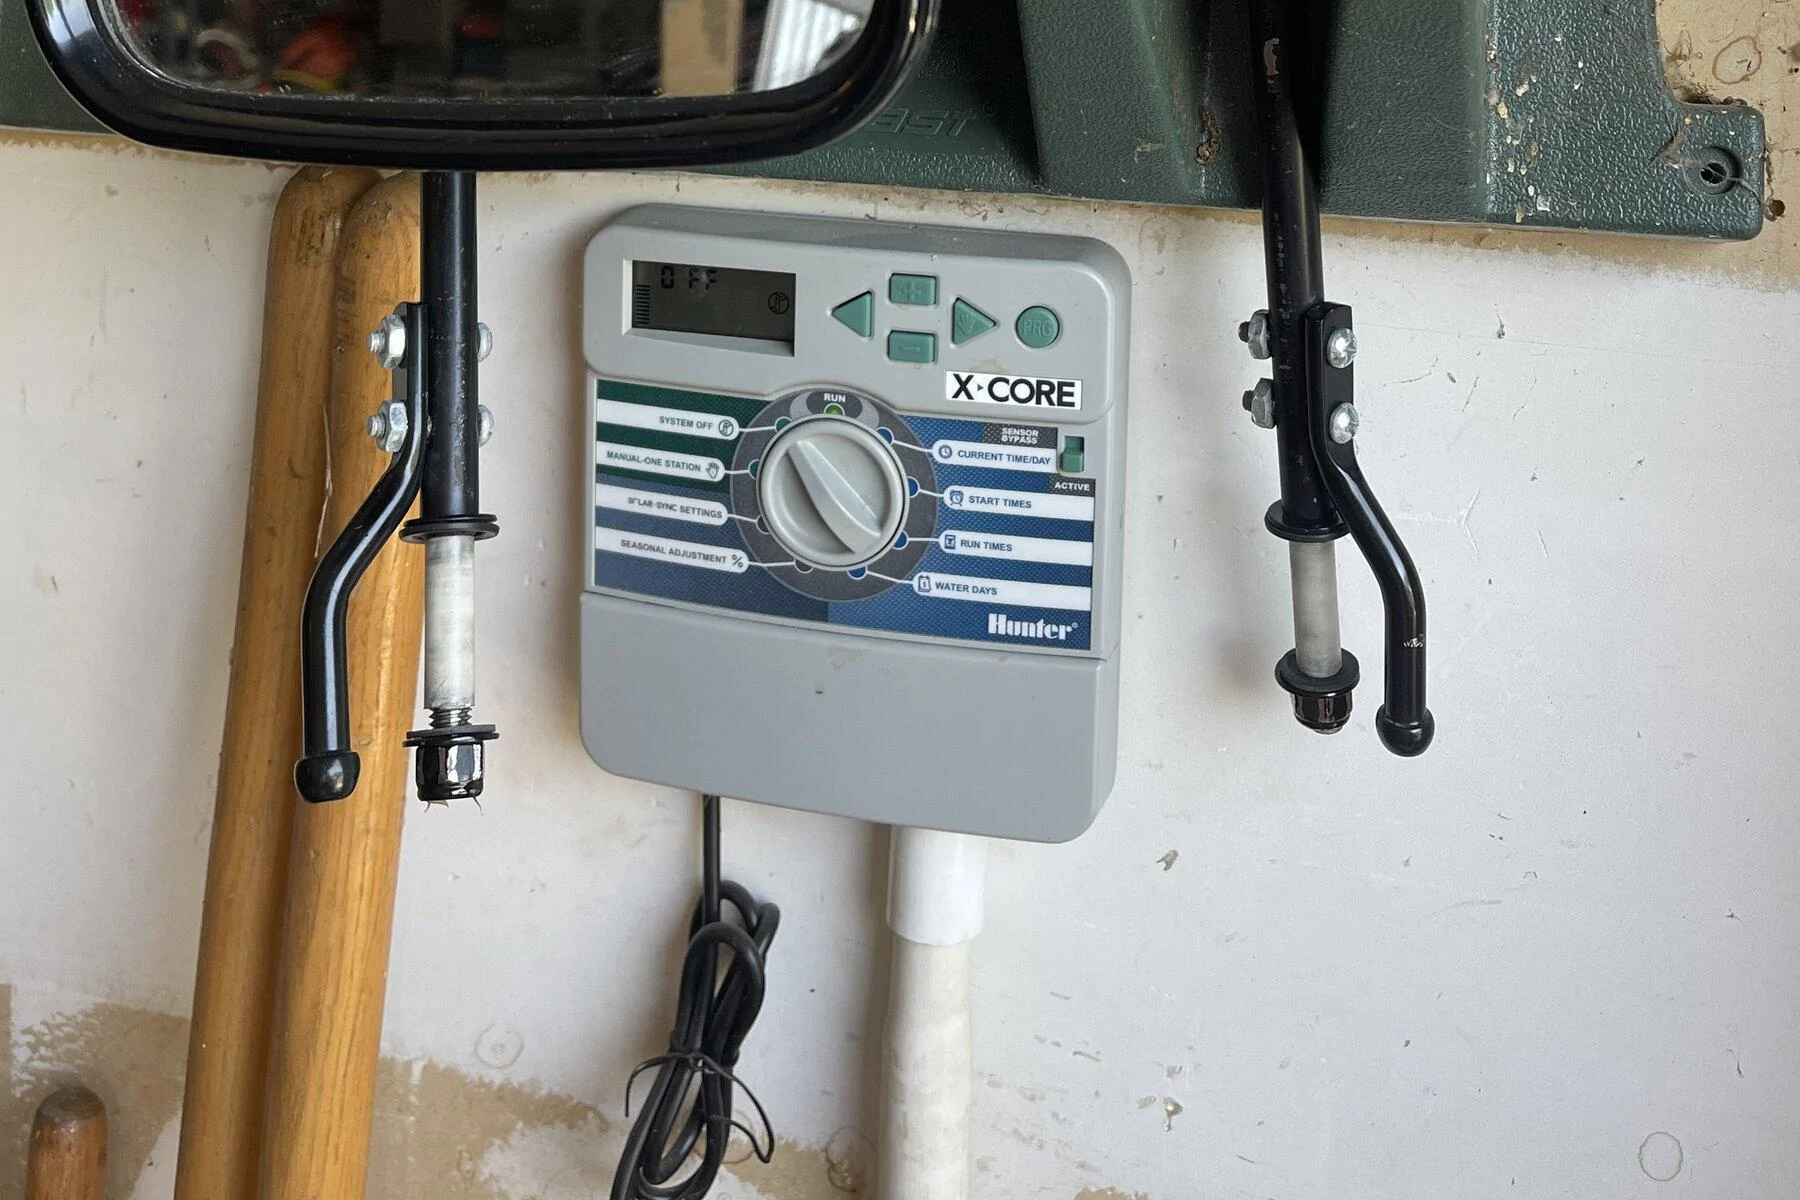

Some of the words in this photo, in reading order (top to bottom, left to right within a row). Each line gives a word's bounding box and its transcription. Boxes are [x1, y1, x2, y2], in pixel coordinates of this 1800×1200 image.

[1021, 318, 1053, 338] PRG
[823, 392, 846, 403] RUN
[658, 415, 695, 428] SYSTEM
[695, 420, 714, 431] OFF
[1001, 427, 1040, 437] SENSOR
[1001, 435, 1038, 445] BYPASS
[606, 450, 663, 466] MANUAL-ONE
[664, 459, 702, 472] STATION
[957, 449, 1003, 462] CURRENT
[1006, 453, 1052, 466] TIME/DAY
[1054, 481, 1091, 491] ACTIVE
[968, 495, 1001, 507] START
[1002, 498, 1032, 509] TIMES
[679, 505, 723, 520] SETTINGS
[620, 538, 667, 555] SEASONAL
[668, 545, 728, 564] ADJUSTMENT
[960, 539, 982, 549] RUN
[983, 541, 1013, 552] TIMES
[935, 581, 970, 593] WATER
[971, 584, 998, 596] DAYS
